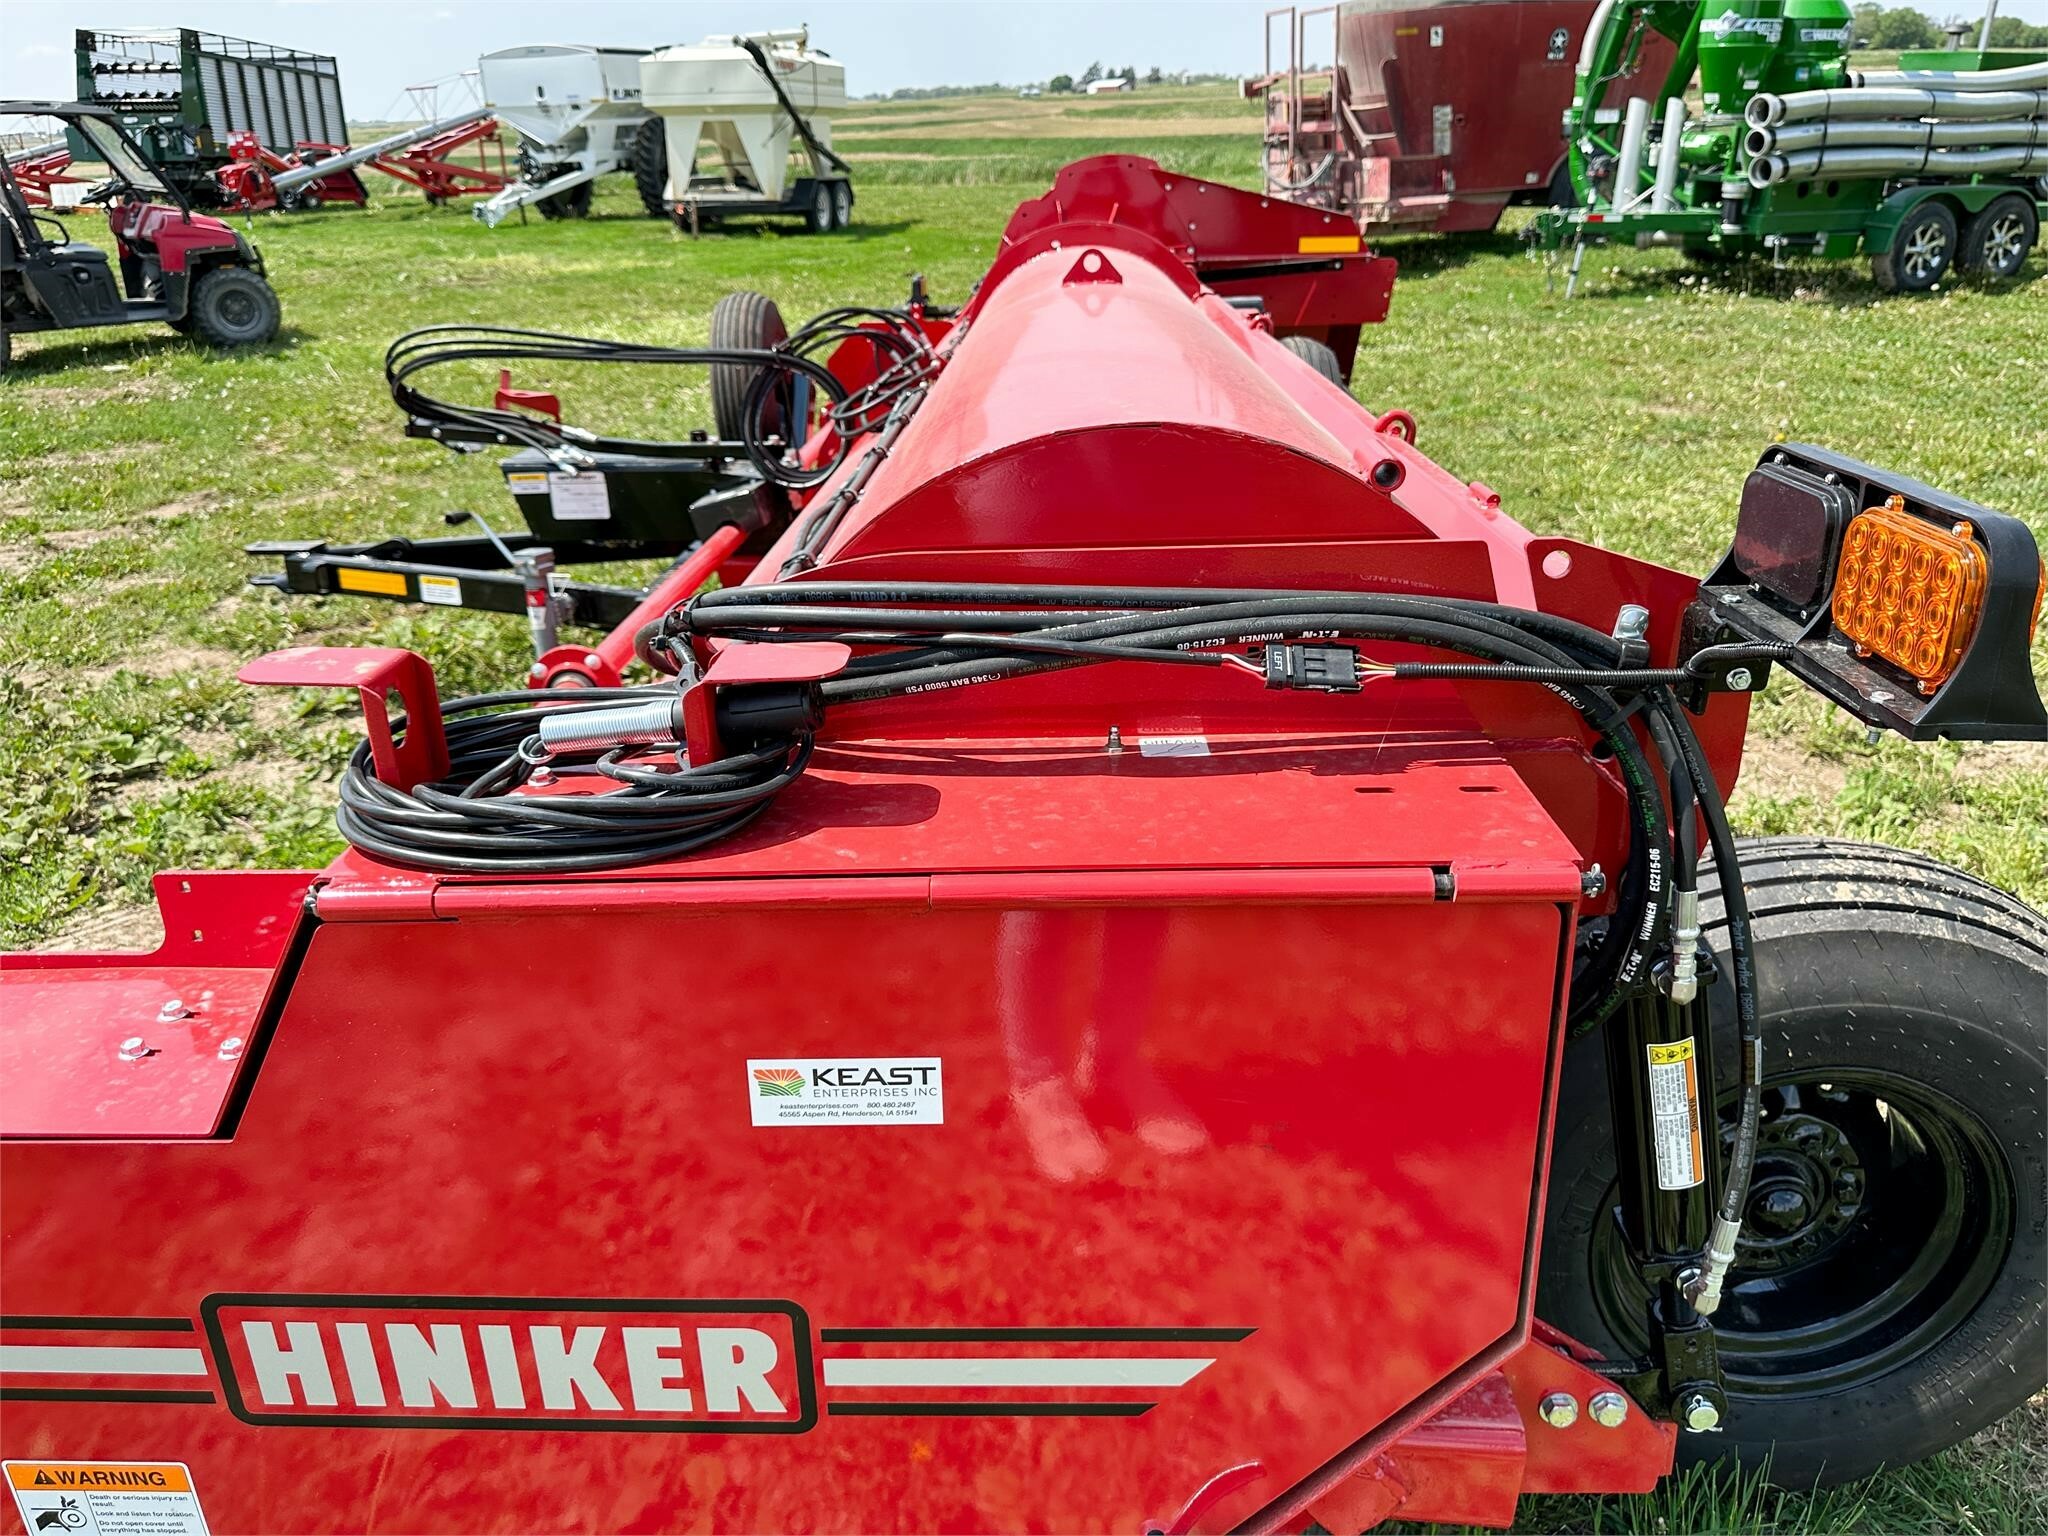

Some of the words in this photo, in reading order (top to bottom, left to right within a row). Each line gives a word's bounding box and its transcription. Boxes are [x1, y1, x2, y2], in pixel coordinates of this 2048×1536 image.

[850, 591, 888, 602] HYBRID
[1177, 637, 1226, 651] EC215-06
[1238, 632, 1284, 644] WINNER
[1273, 651, 1283, 672] LEFT
[925, 679, 950, 691] (5000
[951, 677, 970, 687] BAR
[905, 684, 923, 694] PSI)
[1639, 901, 1658, 941] WINNER
[1649, 848, 1661, 892] EC215-06
[812, 1066, 936, 1086] KEAST
[814, 1088, 909, 1097] ENTERPRISES
[914, 1087, 937, 1096] INC
[780, 1102, 859, 1110] keastenterprises.com
[1688, 1095, 1699, 1132] WARNING
[240, 1320, 788, 1413] HINIKER
[54, 1470, 167, 1486] WARNING
